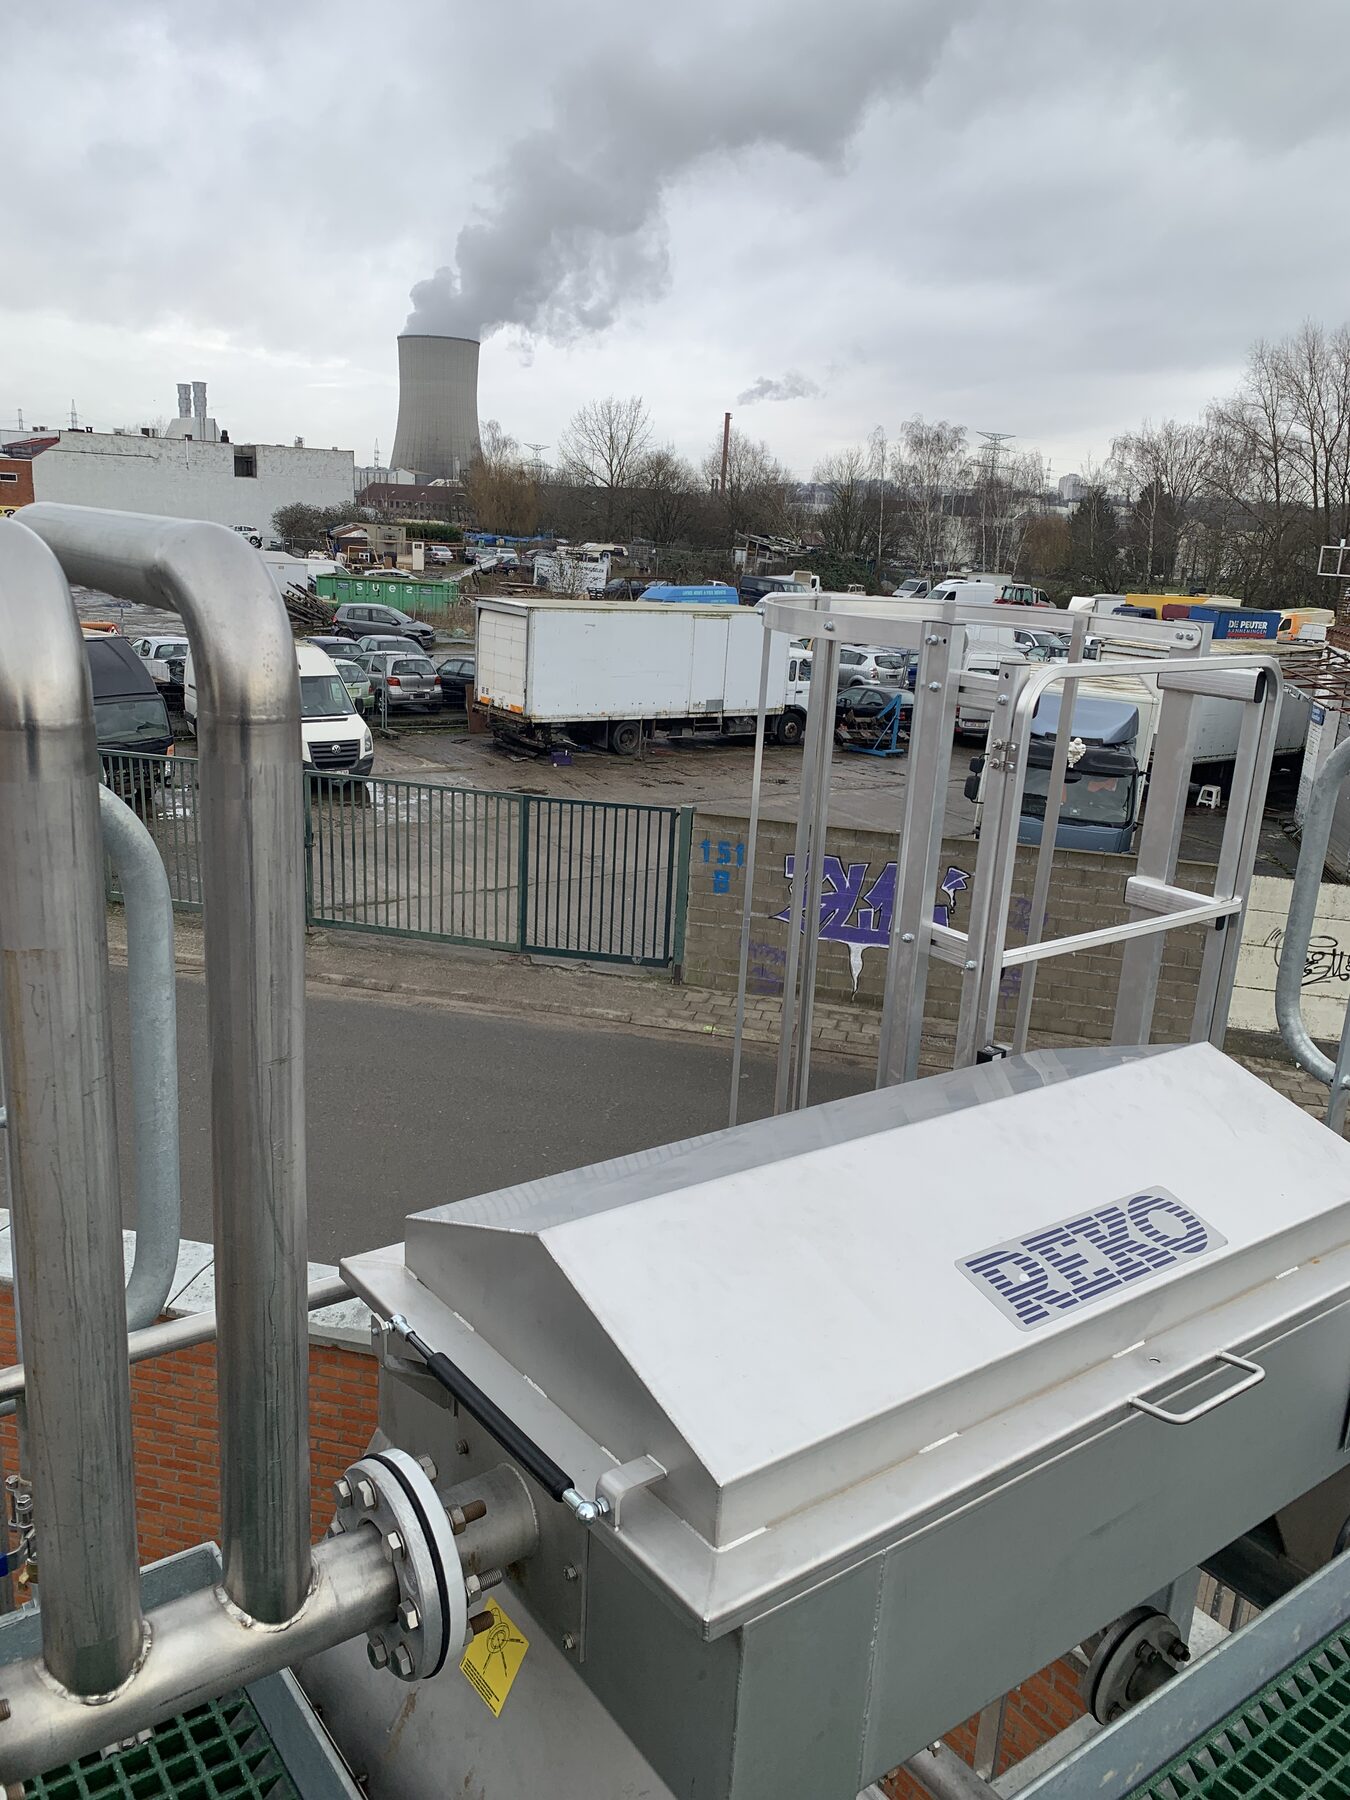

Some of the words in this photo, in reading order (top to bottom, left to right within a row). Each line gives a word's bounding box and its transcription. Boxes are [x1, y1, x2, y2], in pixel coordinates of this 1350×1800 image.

[356, 582, 413, 594] suez
[1228, 620, 1239, 629] DE
[1240, 621, 1268, 630] PEUTER
[700, 839, 745, 868] 151
[712, 870, 731, 894] B
[964, 1195, 1208, 1325] REKO
